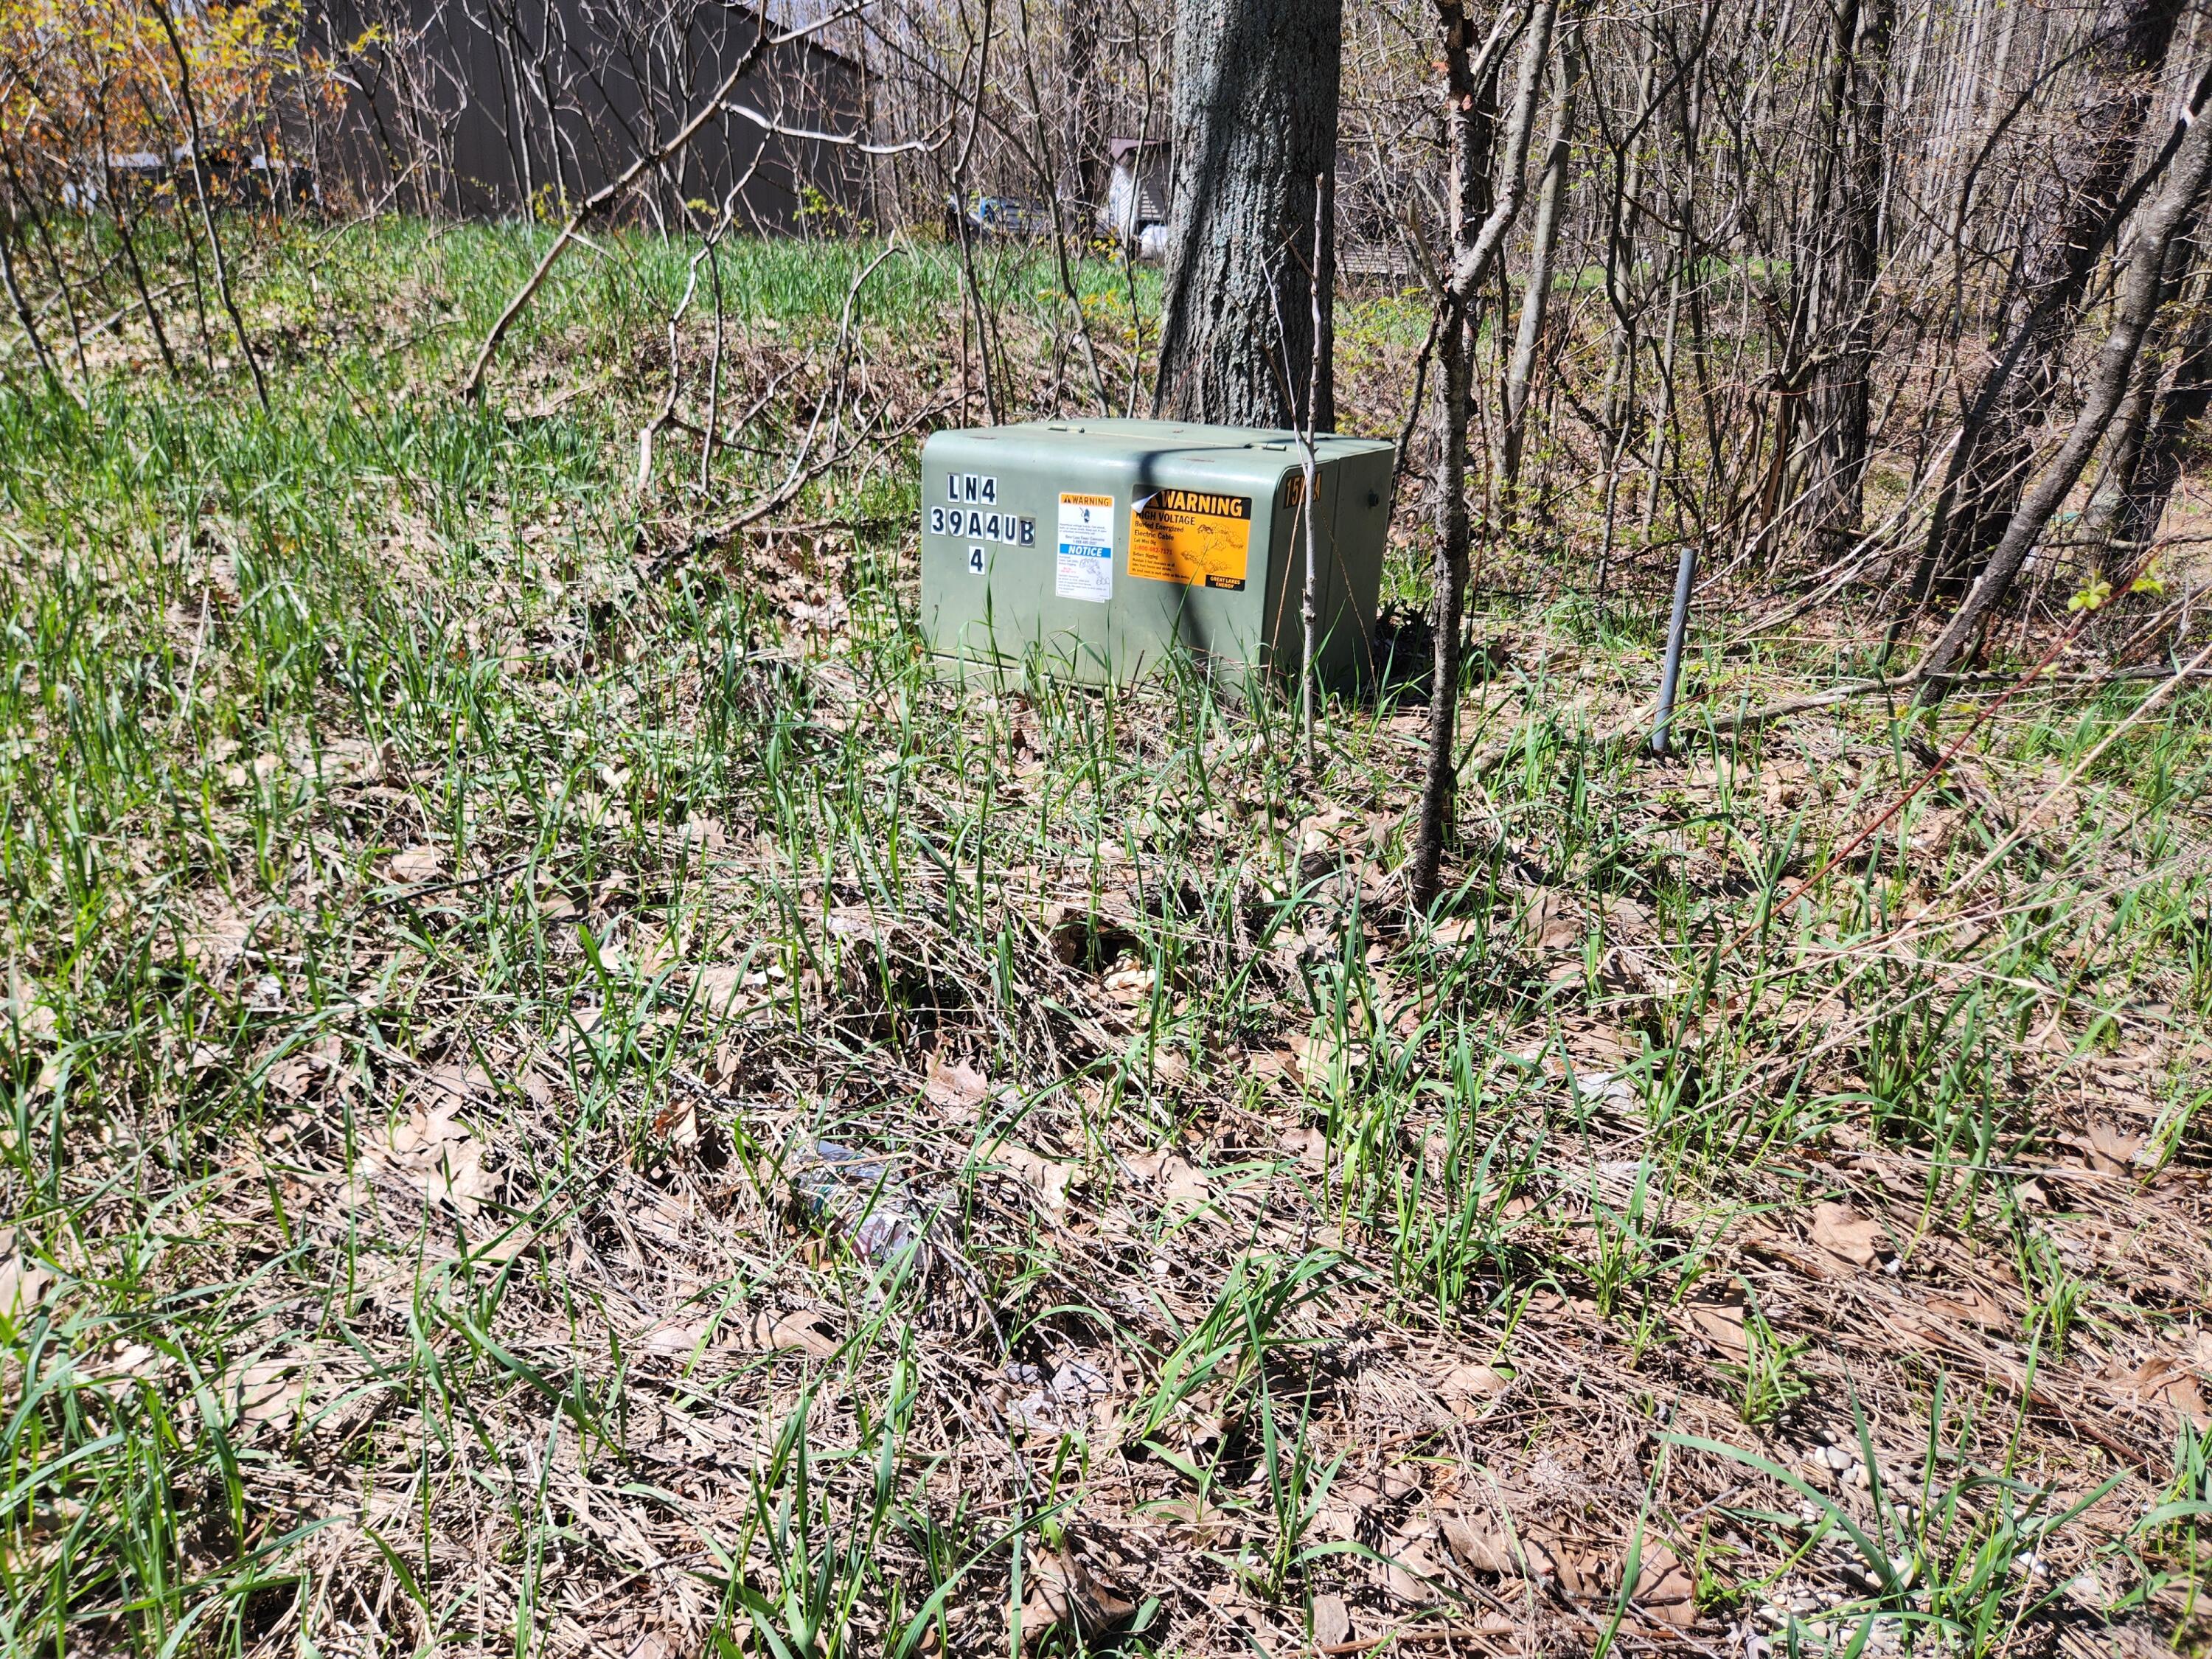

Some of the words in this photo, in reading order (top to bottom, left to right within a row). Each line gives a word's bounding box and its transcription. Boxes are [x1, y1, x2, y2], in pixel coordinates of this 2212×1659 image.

[948, 475, 995, 503] LN4
[1071, 495, 1110, 507] WARNING
[1161, 490, 1243, 518] WARNING
[1158, 512, 1196, 526] VOLTAGE
[931, 508, 1034, 546] 39A4UB
[1135, 521, 1154, 530] Buried
[1155, 522, 1184, 533] Energized
[1134, 529, 1157, 539] Electric
[1158, 532, 1175, 541] Cable
[1068, 545, 1103, 557] NOTICE
[970, 548, 984, 573] 4
[1210, 576, 1226, 584] GREAT
